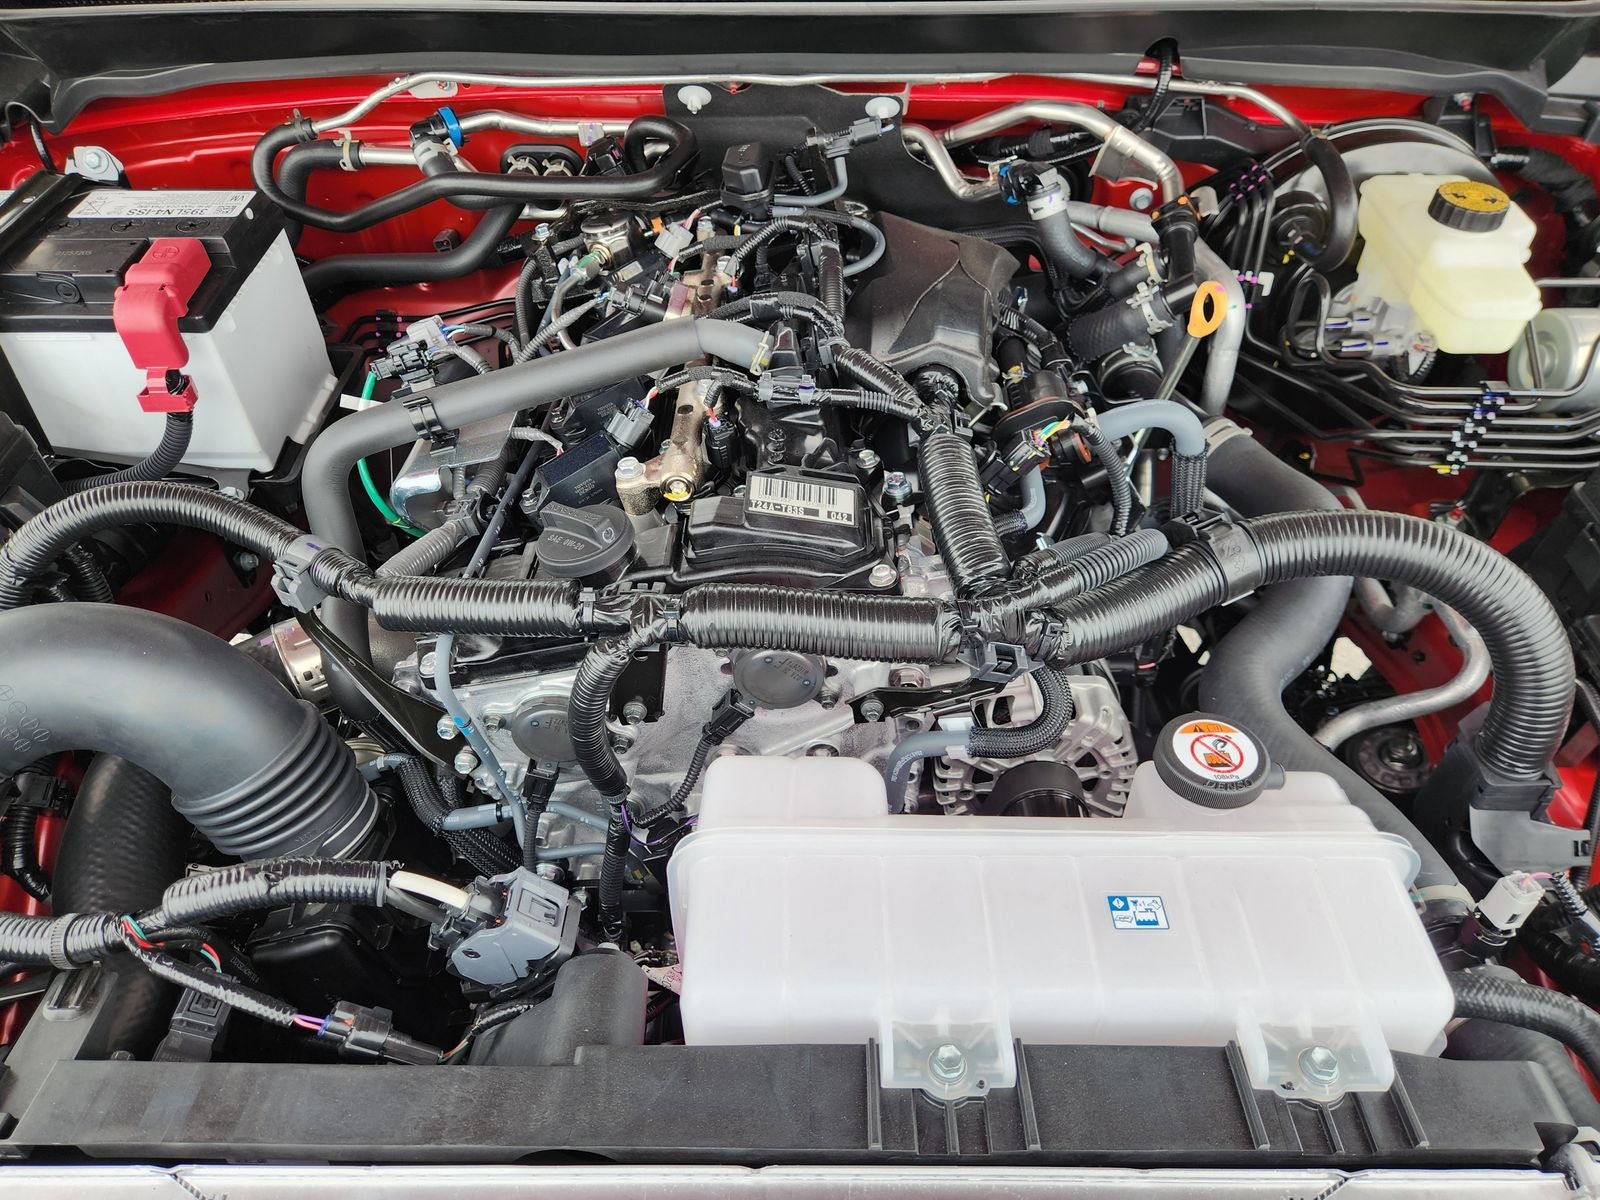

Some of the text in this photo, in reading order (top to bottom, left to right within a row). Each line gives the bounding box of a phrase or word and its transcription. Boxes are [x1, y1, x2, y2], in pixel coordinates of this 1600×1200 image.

[126, 208, 208, 216] 395LN4-ISS
[750, 500, 848, 521] T24A-T83S 042
[548, 535, 585, 551] SAE 0W-20
[1204, 779, 1253, 791] DENSO
